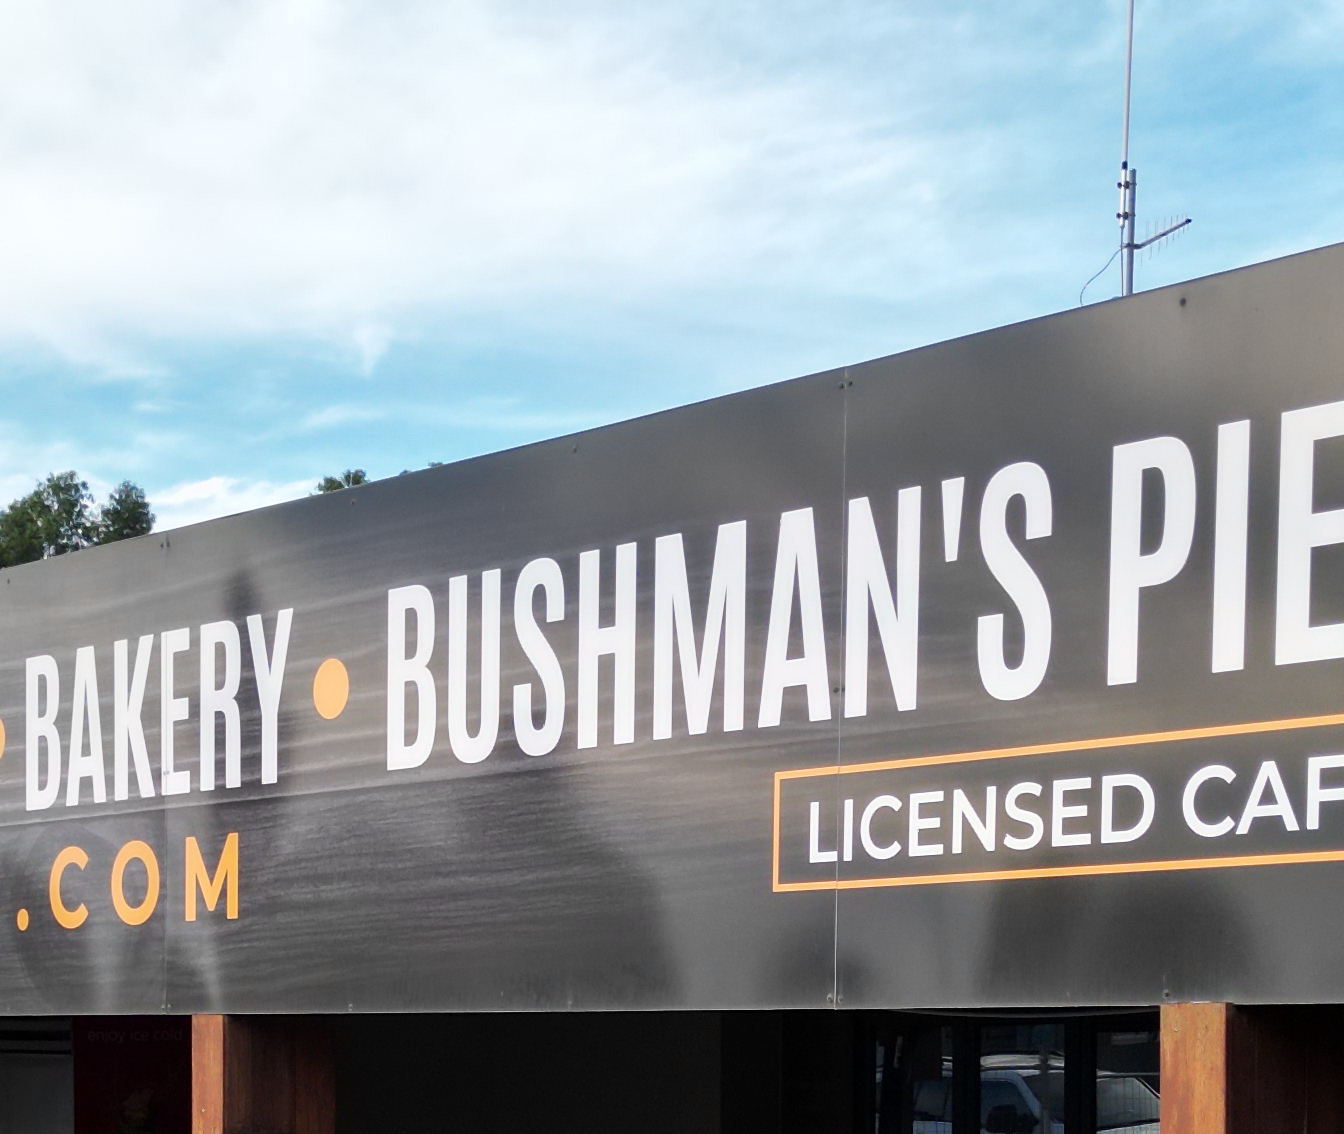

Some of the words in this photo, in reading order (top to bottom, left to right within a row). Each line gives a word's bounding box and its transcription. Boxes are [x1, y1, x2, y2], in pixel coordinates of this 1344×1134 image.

[24, 607, 295, 812] BAKERY
[386, 460, 1054, 771] BUSHMAN'S
[807, 771, 1156, 865] LICENSED
